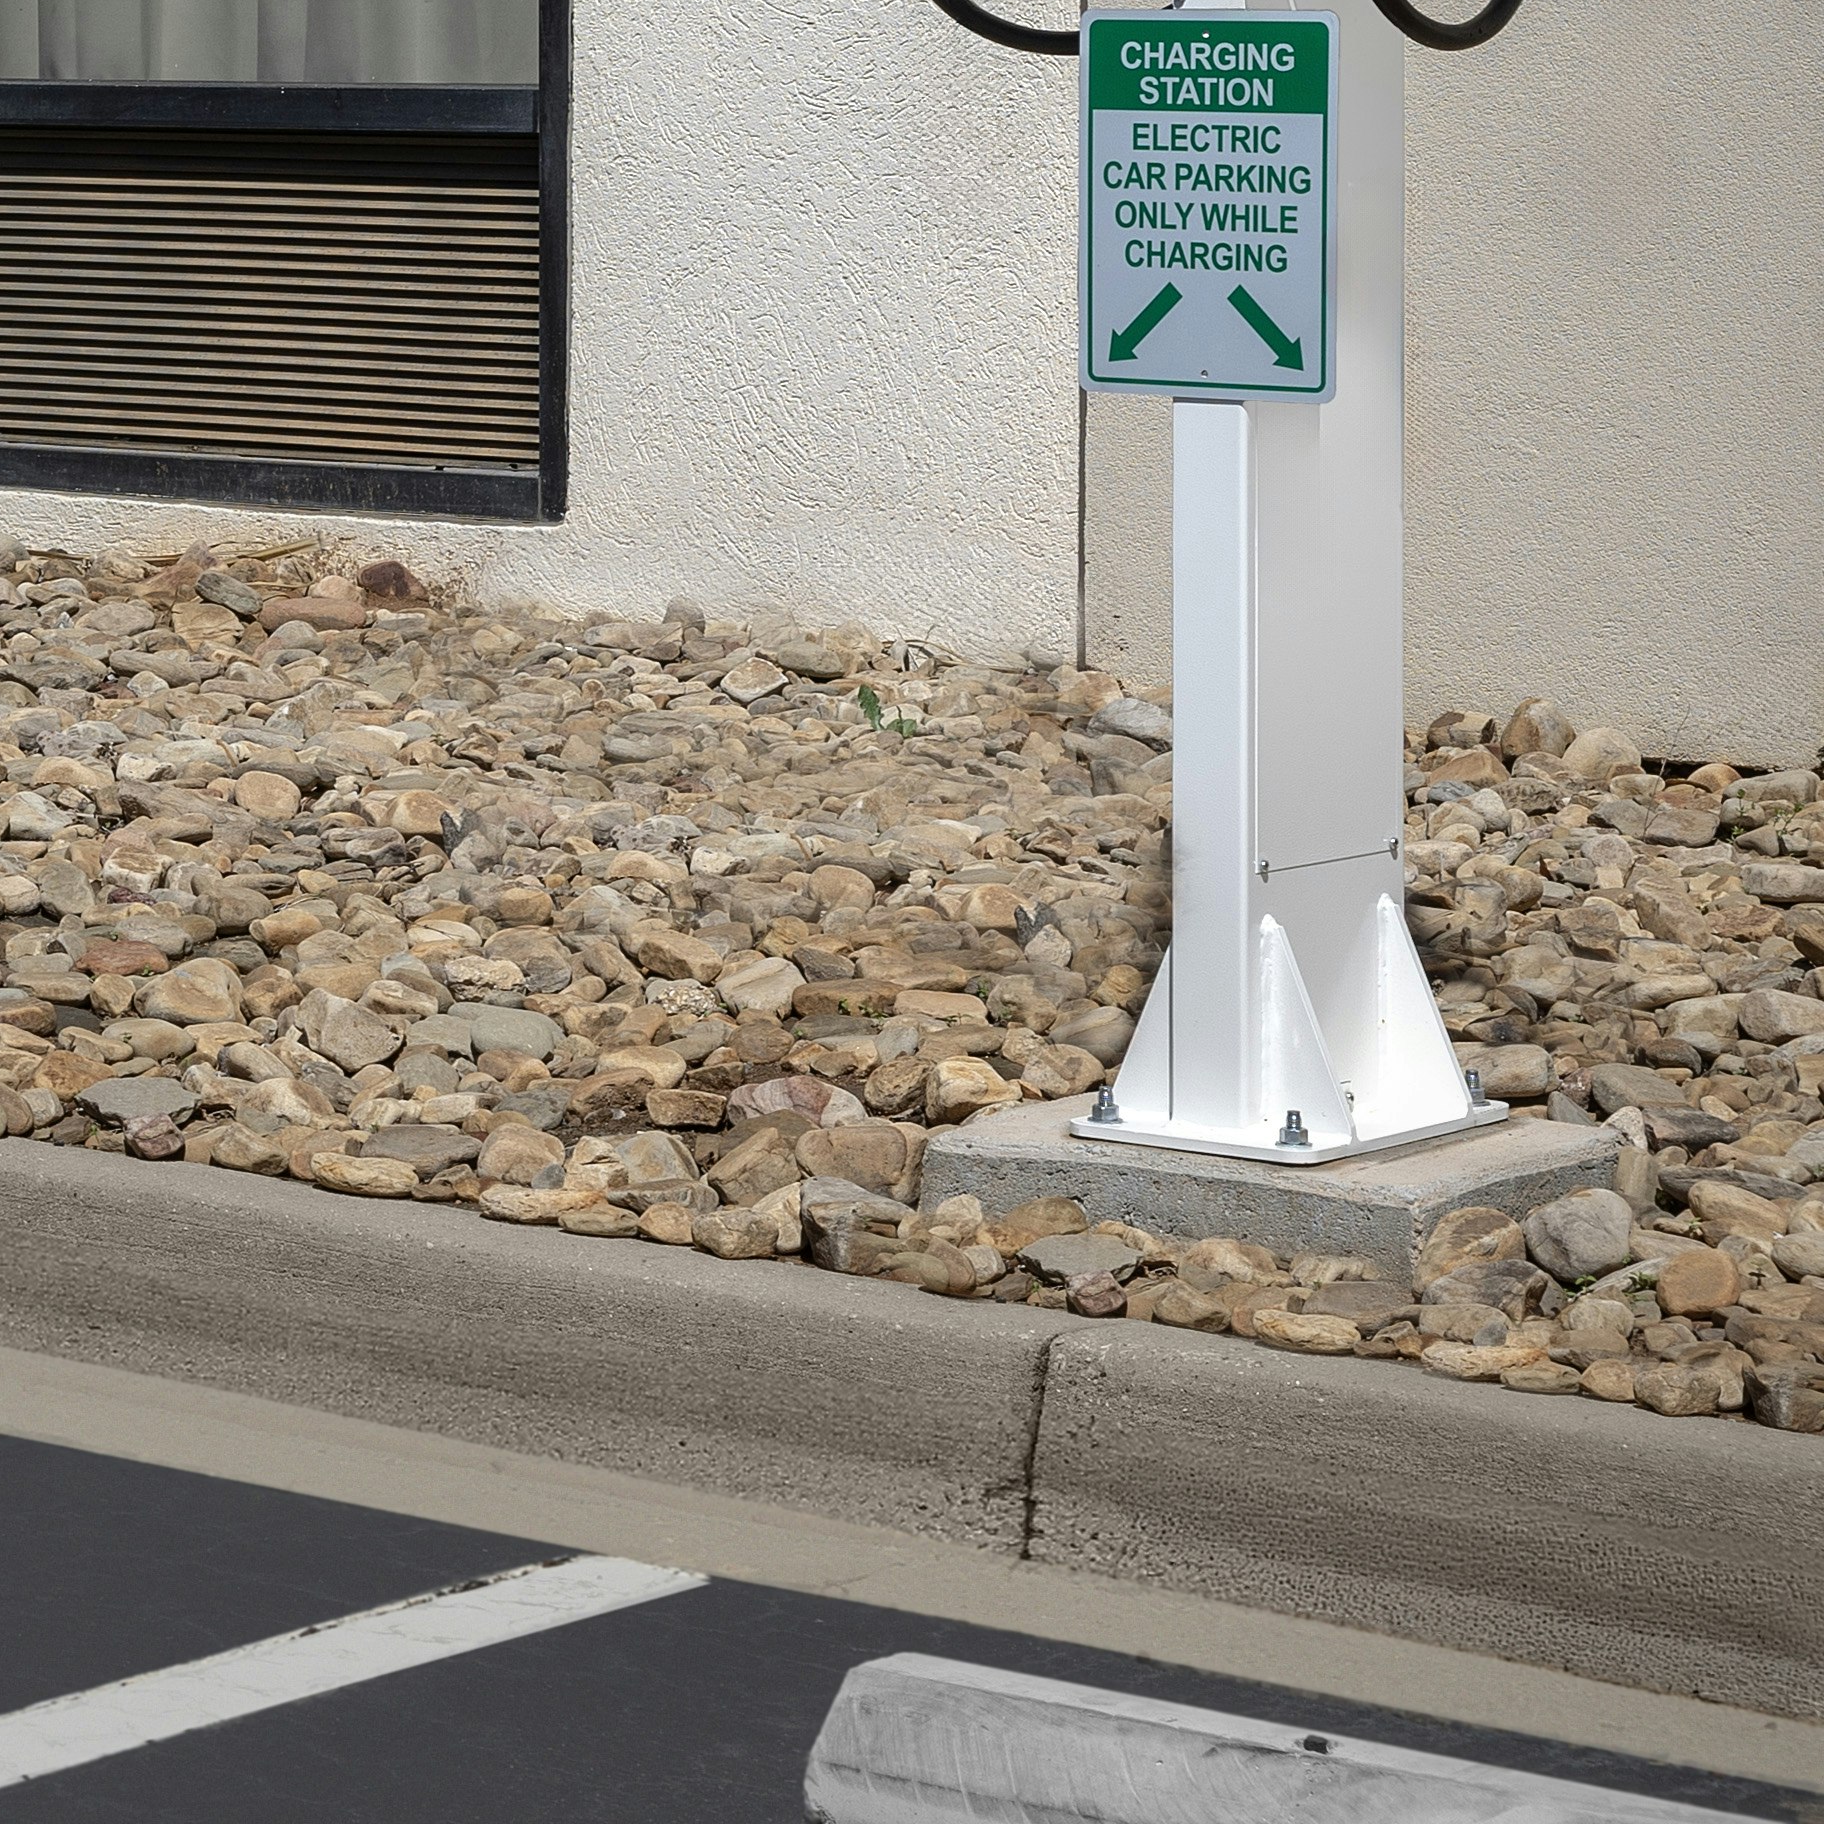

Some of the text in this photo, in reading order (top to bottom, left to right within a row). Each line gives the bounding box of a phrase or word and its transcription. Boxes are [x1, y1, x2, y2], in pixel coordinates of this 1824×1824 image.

[1120, 41, 1295, 72] CHARGING
[1139, 76, 1274, 107] STATION
[1132, 122, 1282, 154] ELECTRIC
[1103, 161, 1312, 195] CAR PARKING
[1115, 200, 1299, 234] ONLY WHILE
[1124, 238, 1288, 273] CHARGING
